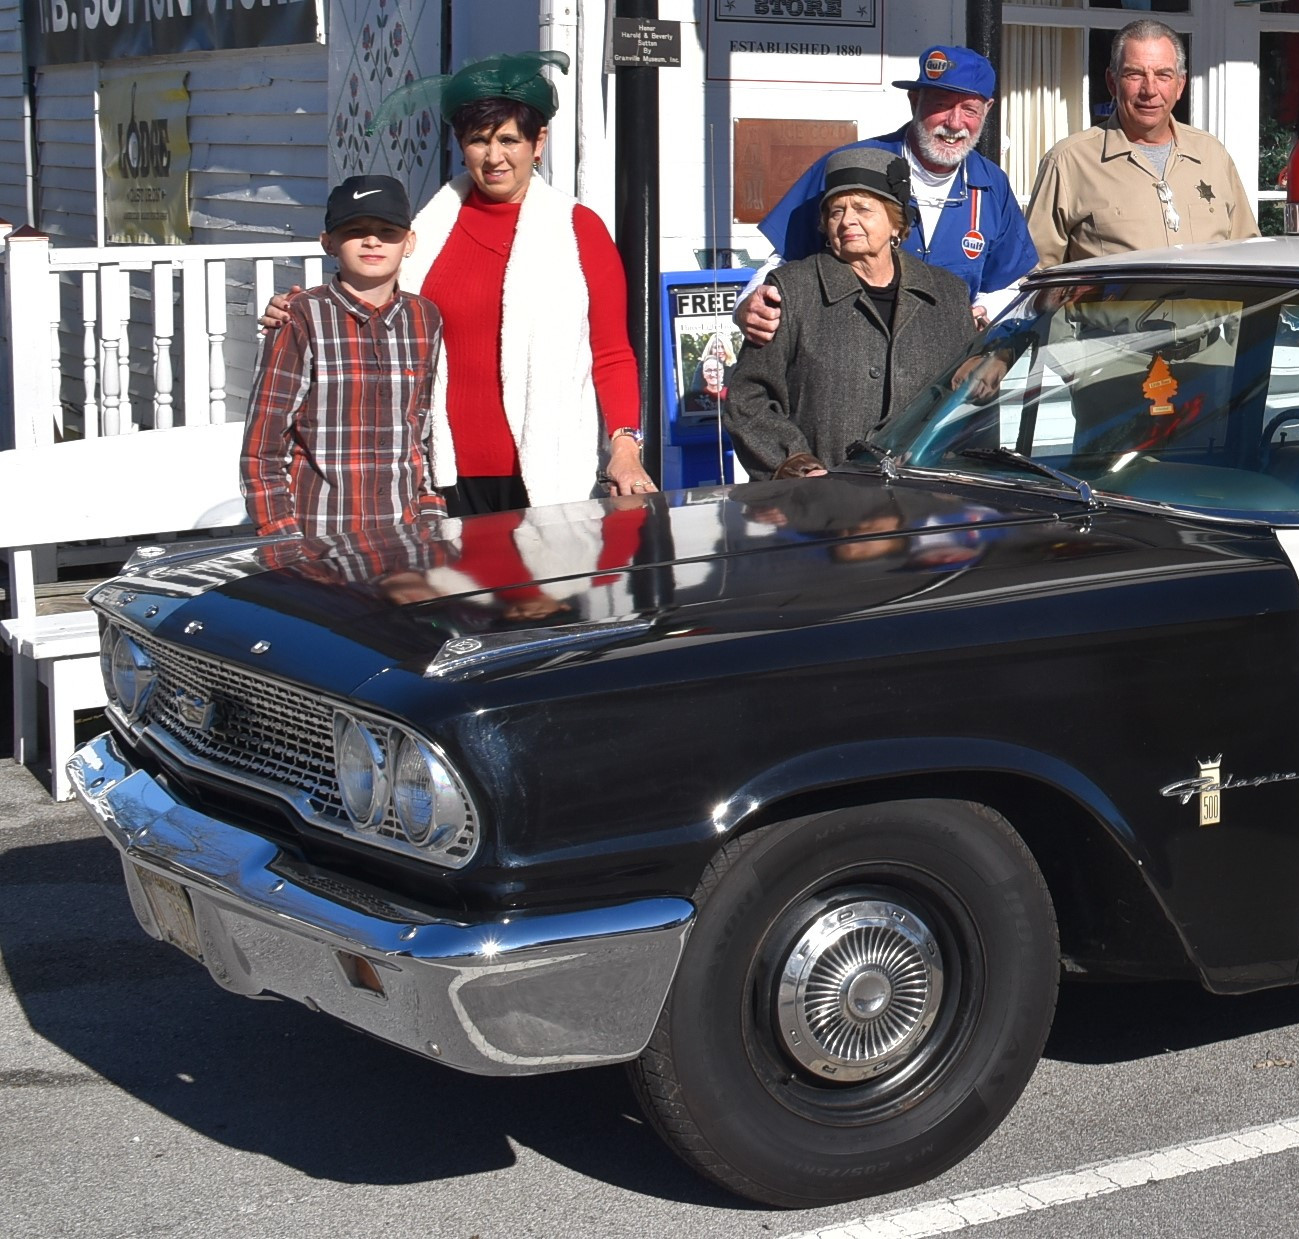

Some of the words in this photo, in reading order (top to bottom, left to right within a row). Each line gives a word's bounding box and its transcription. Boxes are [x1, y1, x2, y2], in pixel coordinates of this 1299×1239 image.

[651, 32, 674, 41] Beverly
[637, 39, 658, 47] Sutton
[729, 40, 831, 56] ESTABLISHED
[835, 44, 862, 57] 1880
[643, 47, 652, 55] By
[614, 54, 640, 62] Granville
[926, 60, 947, 71] Gulf
[962, 238, 984, 251] Gulf
[677, 292, 736, 315] FREE
[1203, 794, 1219, 820] 500
